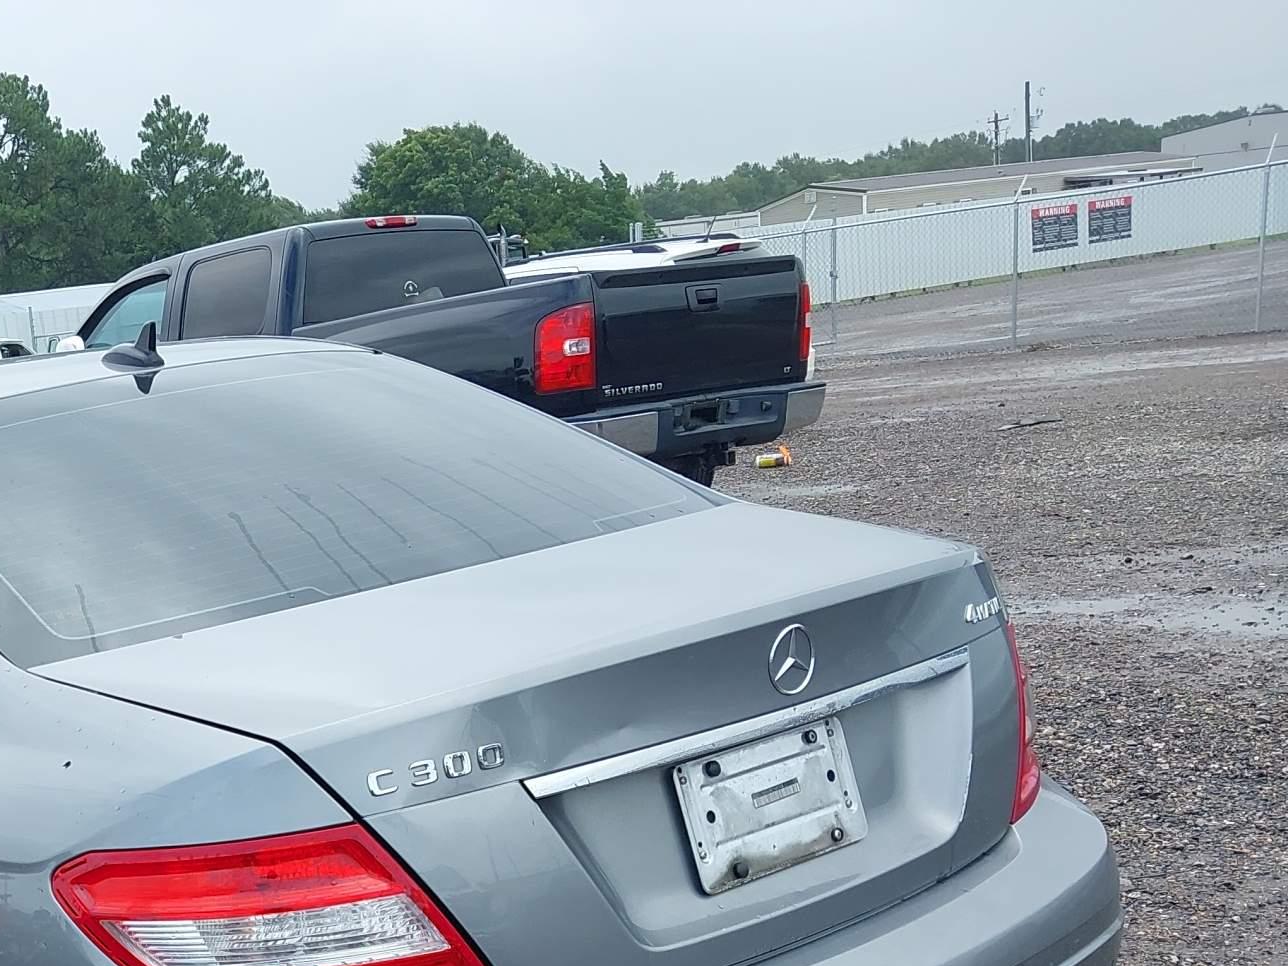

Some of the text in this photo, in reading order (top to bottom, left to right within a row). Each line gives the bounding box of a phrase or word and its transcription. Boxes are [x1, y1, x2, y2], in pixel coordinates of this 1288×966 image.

[1095, 198, 1125, 209] WARNING
[1039, 206, 1070, 217] WARNING
[604, 382, 663, 397] SILVERADO
[367, 743, 504, 797] C 300
